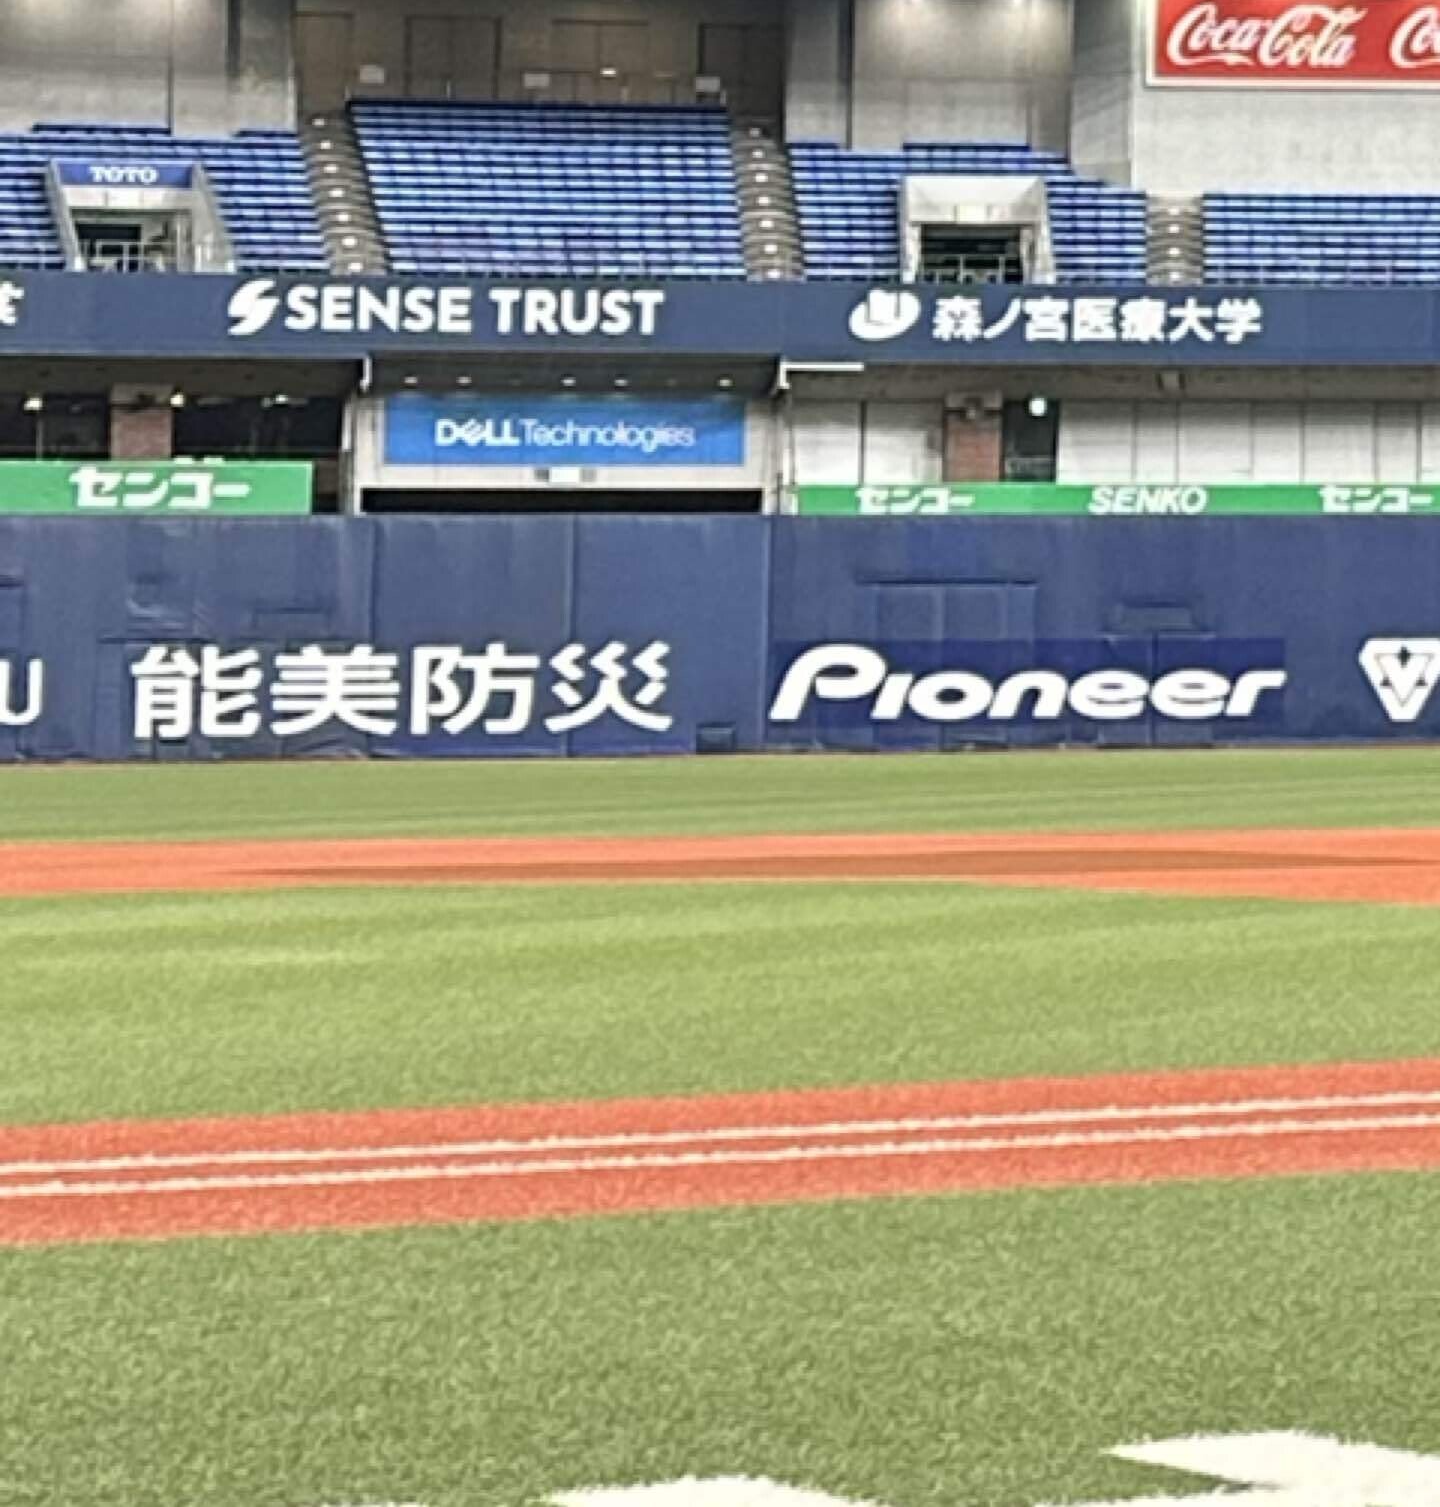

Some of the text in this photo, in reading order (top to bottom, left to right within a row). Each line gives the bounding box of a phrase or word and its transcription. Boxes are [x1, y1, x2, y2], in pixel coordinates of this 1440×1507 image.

[1166, 3, 1368, 69] Coca-Cola
[89, 166, 158, 184] TOTO
[284, 286, 665, 334] SENSE TRUST
[932, 295, 1262, 342] 森ノ宮医療大学
[436, 419, 696, 451] DELL Technologies
[69, 466, 251, 509] センコー
[857, 486, 976, 515] センコー
[1087, 485, 1208, 515] SENKO
[1318, 484, 1433, 513] センコー
[130, 642, 673, 738] 能美防災
[770, 645, 1286, 721] Pioneer
